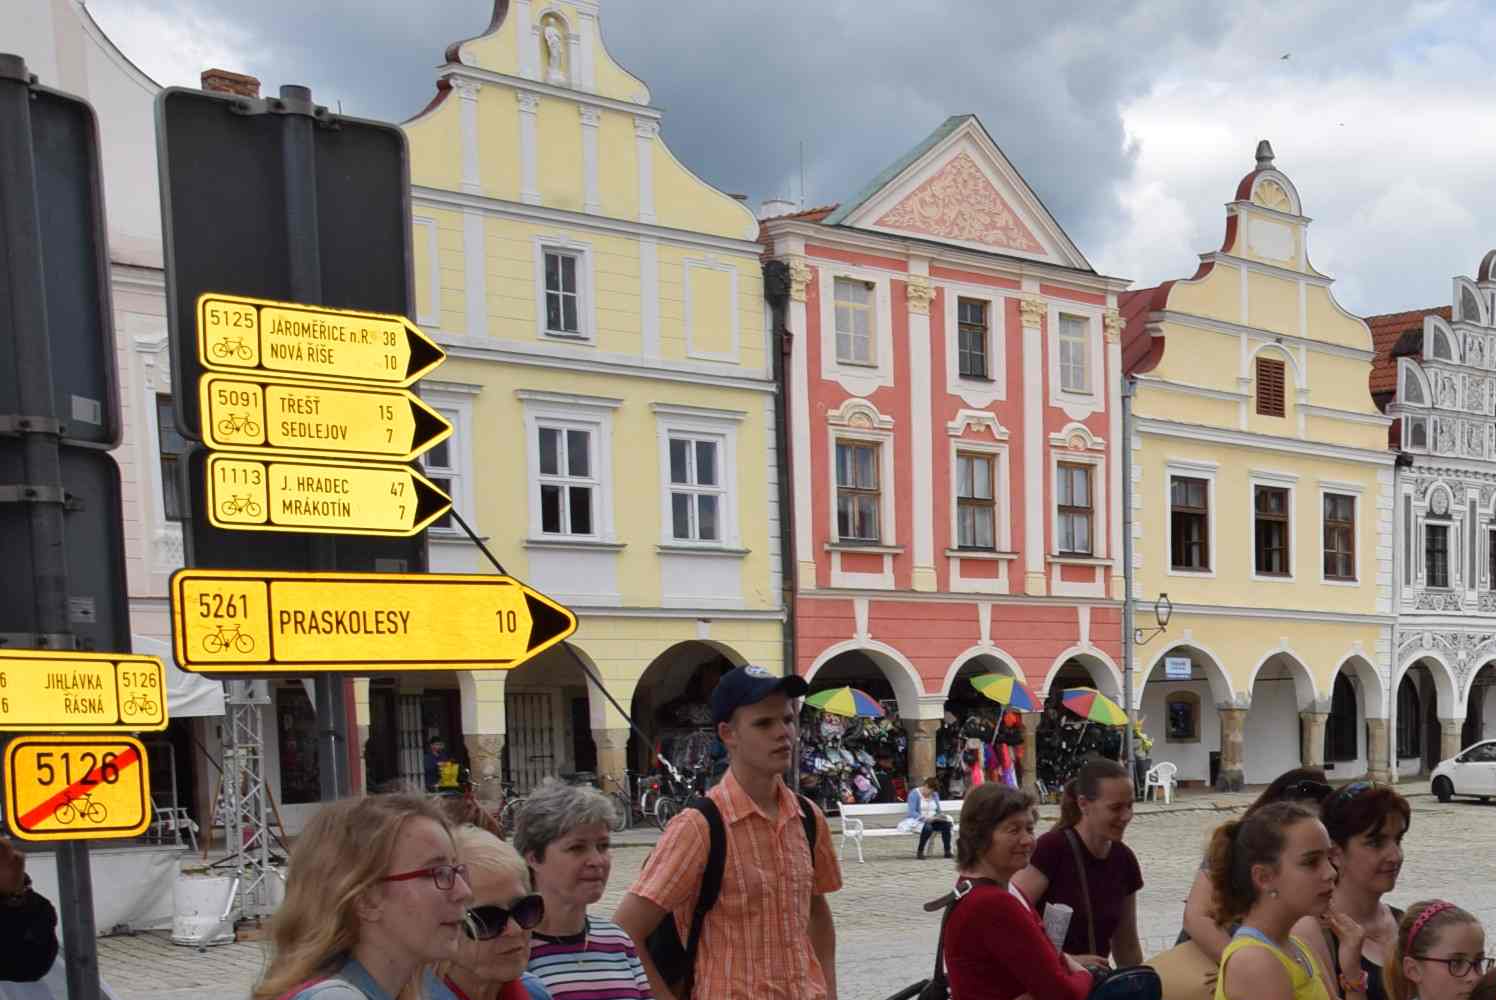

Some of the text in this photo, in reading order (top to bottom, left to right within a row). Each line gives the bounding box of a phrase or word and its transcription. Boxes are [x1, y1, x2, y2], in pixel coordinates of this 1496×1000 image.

[210, 309, 254, 328] 5125
[269, 318, 397, 346] JAROMĚŘICE n.R. 38
[270, 342, 397, 370] NOVÁ ŘÍŠE 10
[218, 389, 259, 409] 5091
[280, 393, 393, 420] TŘEŠŤ 15
[281, 420, 393, 443] SEDLEJOV 7
[220, 467, 261, 485] 1113
[281, 475, 405, 497] J. HRADEC 47
[282, 496, 405, 520] MRÁKOTÍN 7
[199, 593, 249, 619] 5261
[279, 610, 517, 635] PRASKOLESY 10
[44, 669, 103, 690] JIHLÁVKA
[122, 671, 158, 688] 5126
[64, 691, 105, 714] ŘÁSNÁ
[36, 752, 120, 786] 5126
